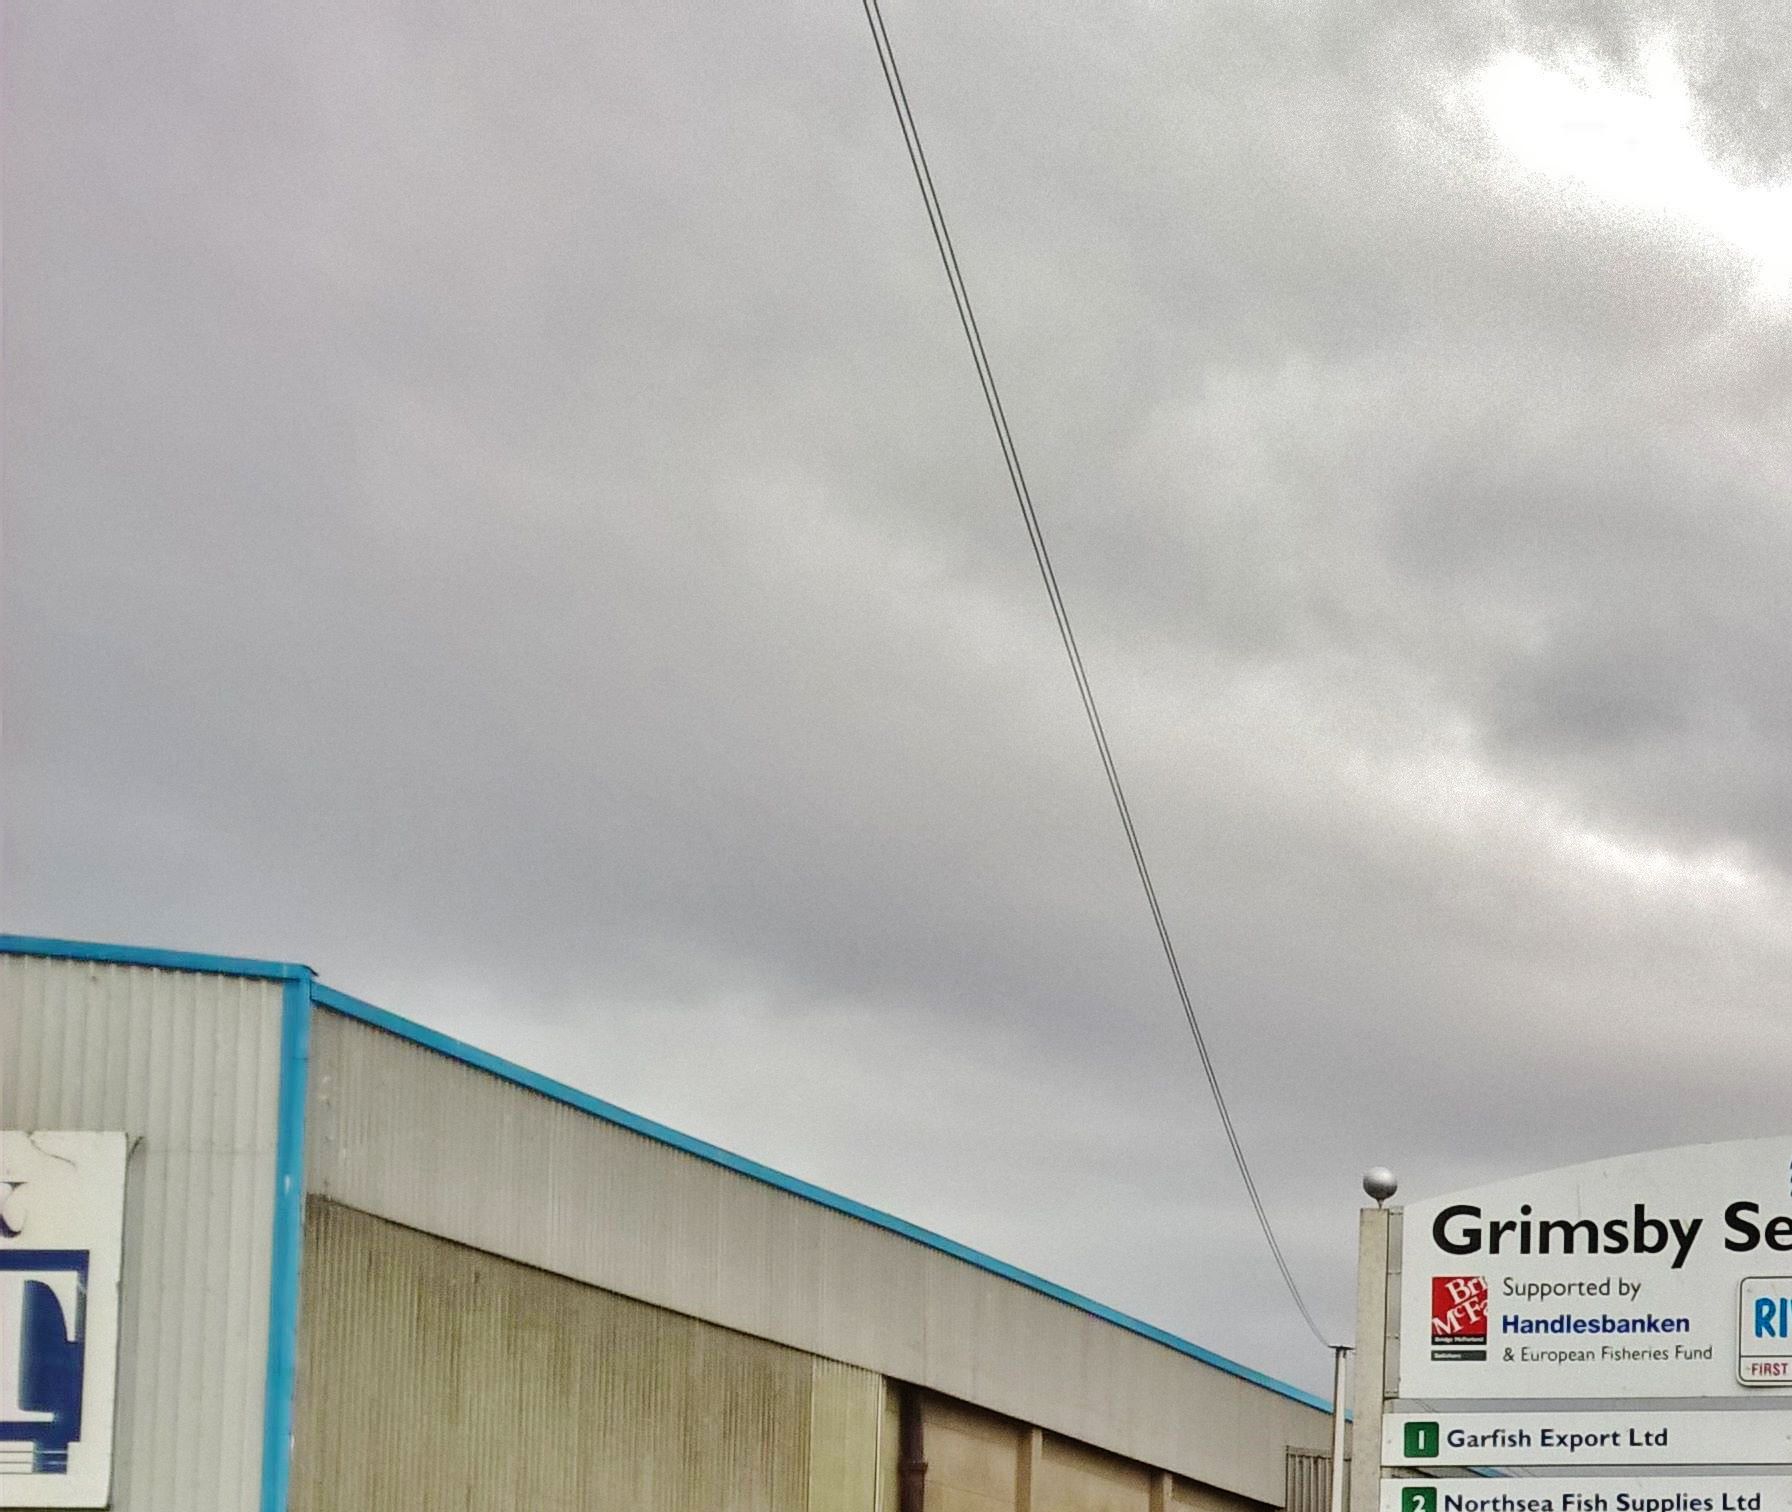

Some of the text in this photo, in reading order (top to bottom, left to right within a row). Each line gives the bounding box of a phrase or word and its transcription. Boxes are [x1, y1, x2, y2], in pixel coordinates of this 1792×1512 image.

[1431, 1204, 1704, 1268] Grimsby
[1503, 1277, 1641, 1300] Supported by
[1502, 1315, 1689, 1333] Handlesbanken
[1503, 1345, 1712, 1364] & European Fisheries Fund
[1752, 1363, 1788, 1375] FIRST
[1447, 1429, 1531, 1447] Garfish
[1540, 1430, 1620, 1451] Export
[1629, 1428, 1668, 1446] Ltd
[1444, 1495, 1553, 1512] Northsea
[1563, 1493, 1608, 1511] Fish
[1722, 1493, 1760, 1511] Ltd
